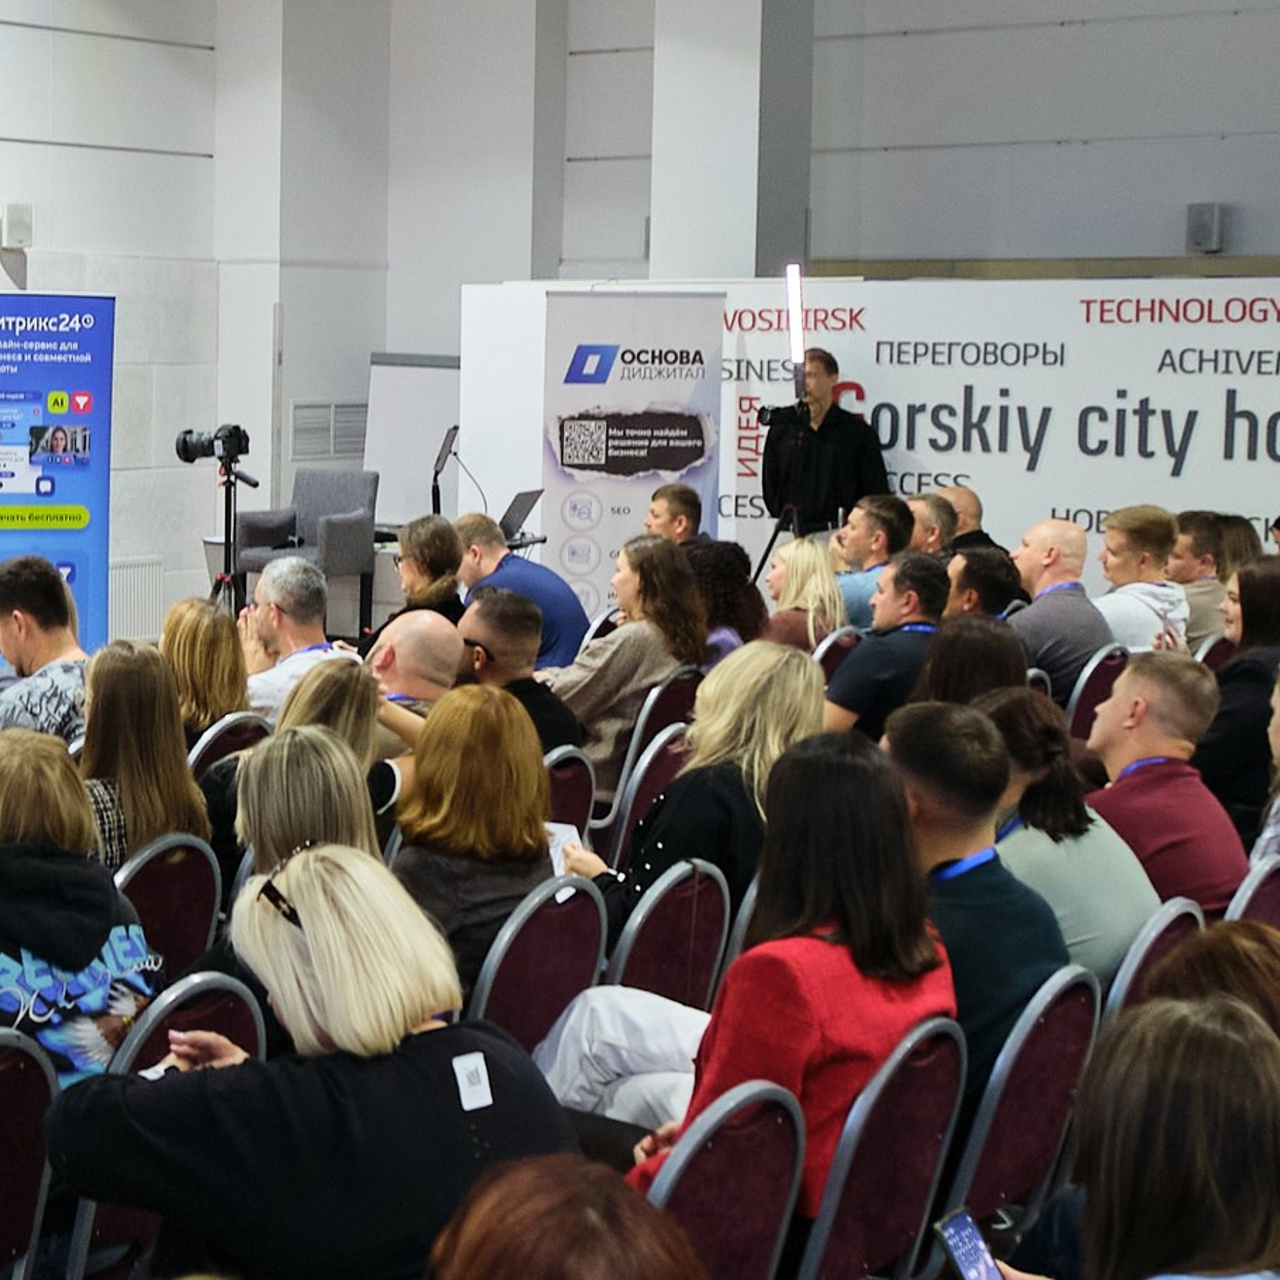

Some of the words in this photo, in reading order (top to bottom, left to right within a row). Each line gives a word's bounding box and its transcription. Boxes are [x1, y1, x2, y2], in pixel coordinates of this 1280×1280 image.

[723, 306, 866, 332] VOSIIRSK
[59, 341, 79, 351] для
[875, 340, 1065, 367] ПЕРЕГОВОРЫ
[24, 352, 32, 362] и
[33, 352, 93, 363] совместной
[620, 349, 704, 365] ОСНОВА
[1157, 348, 1280, 376] ACHIVE
[619, 366, 706, 381] ДИДЖИТАЛ
[52, 398, 64, 408] AI
[737, 395, 765, 478] ИДЕЯ
[1077, 388, 1199, 477] city
[610, 506, 631, 515] SEO
